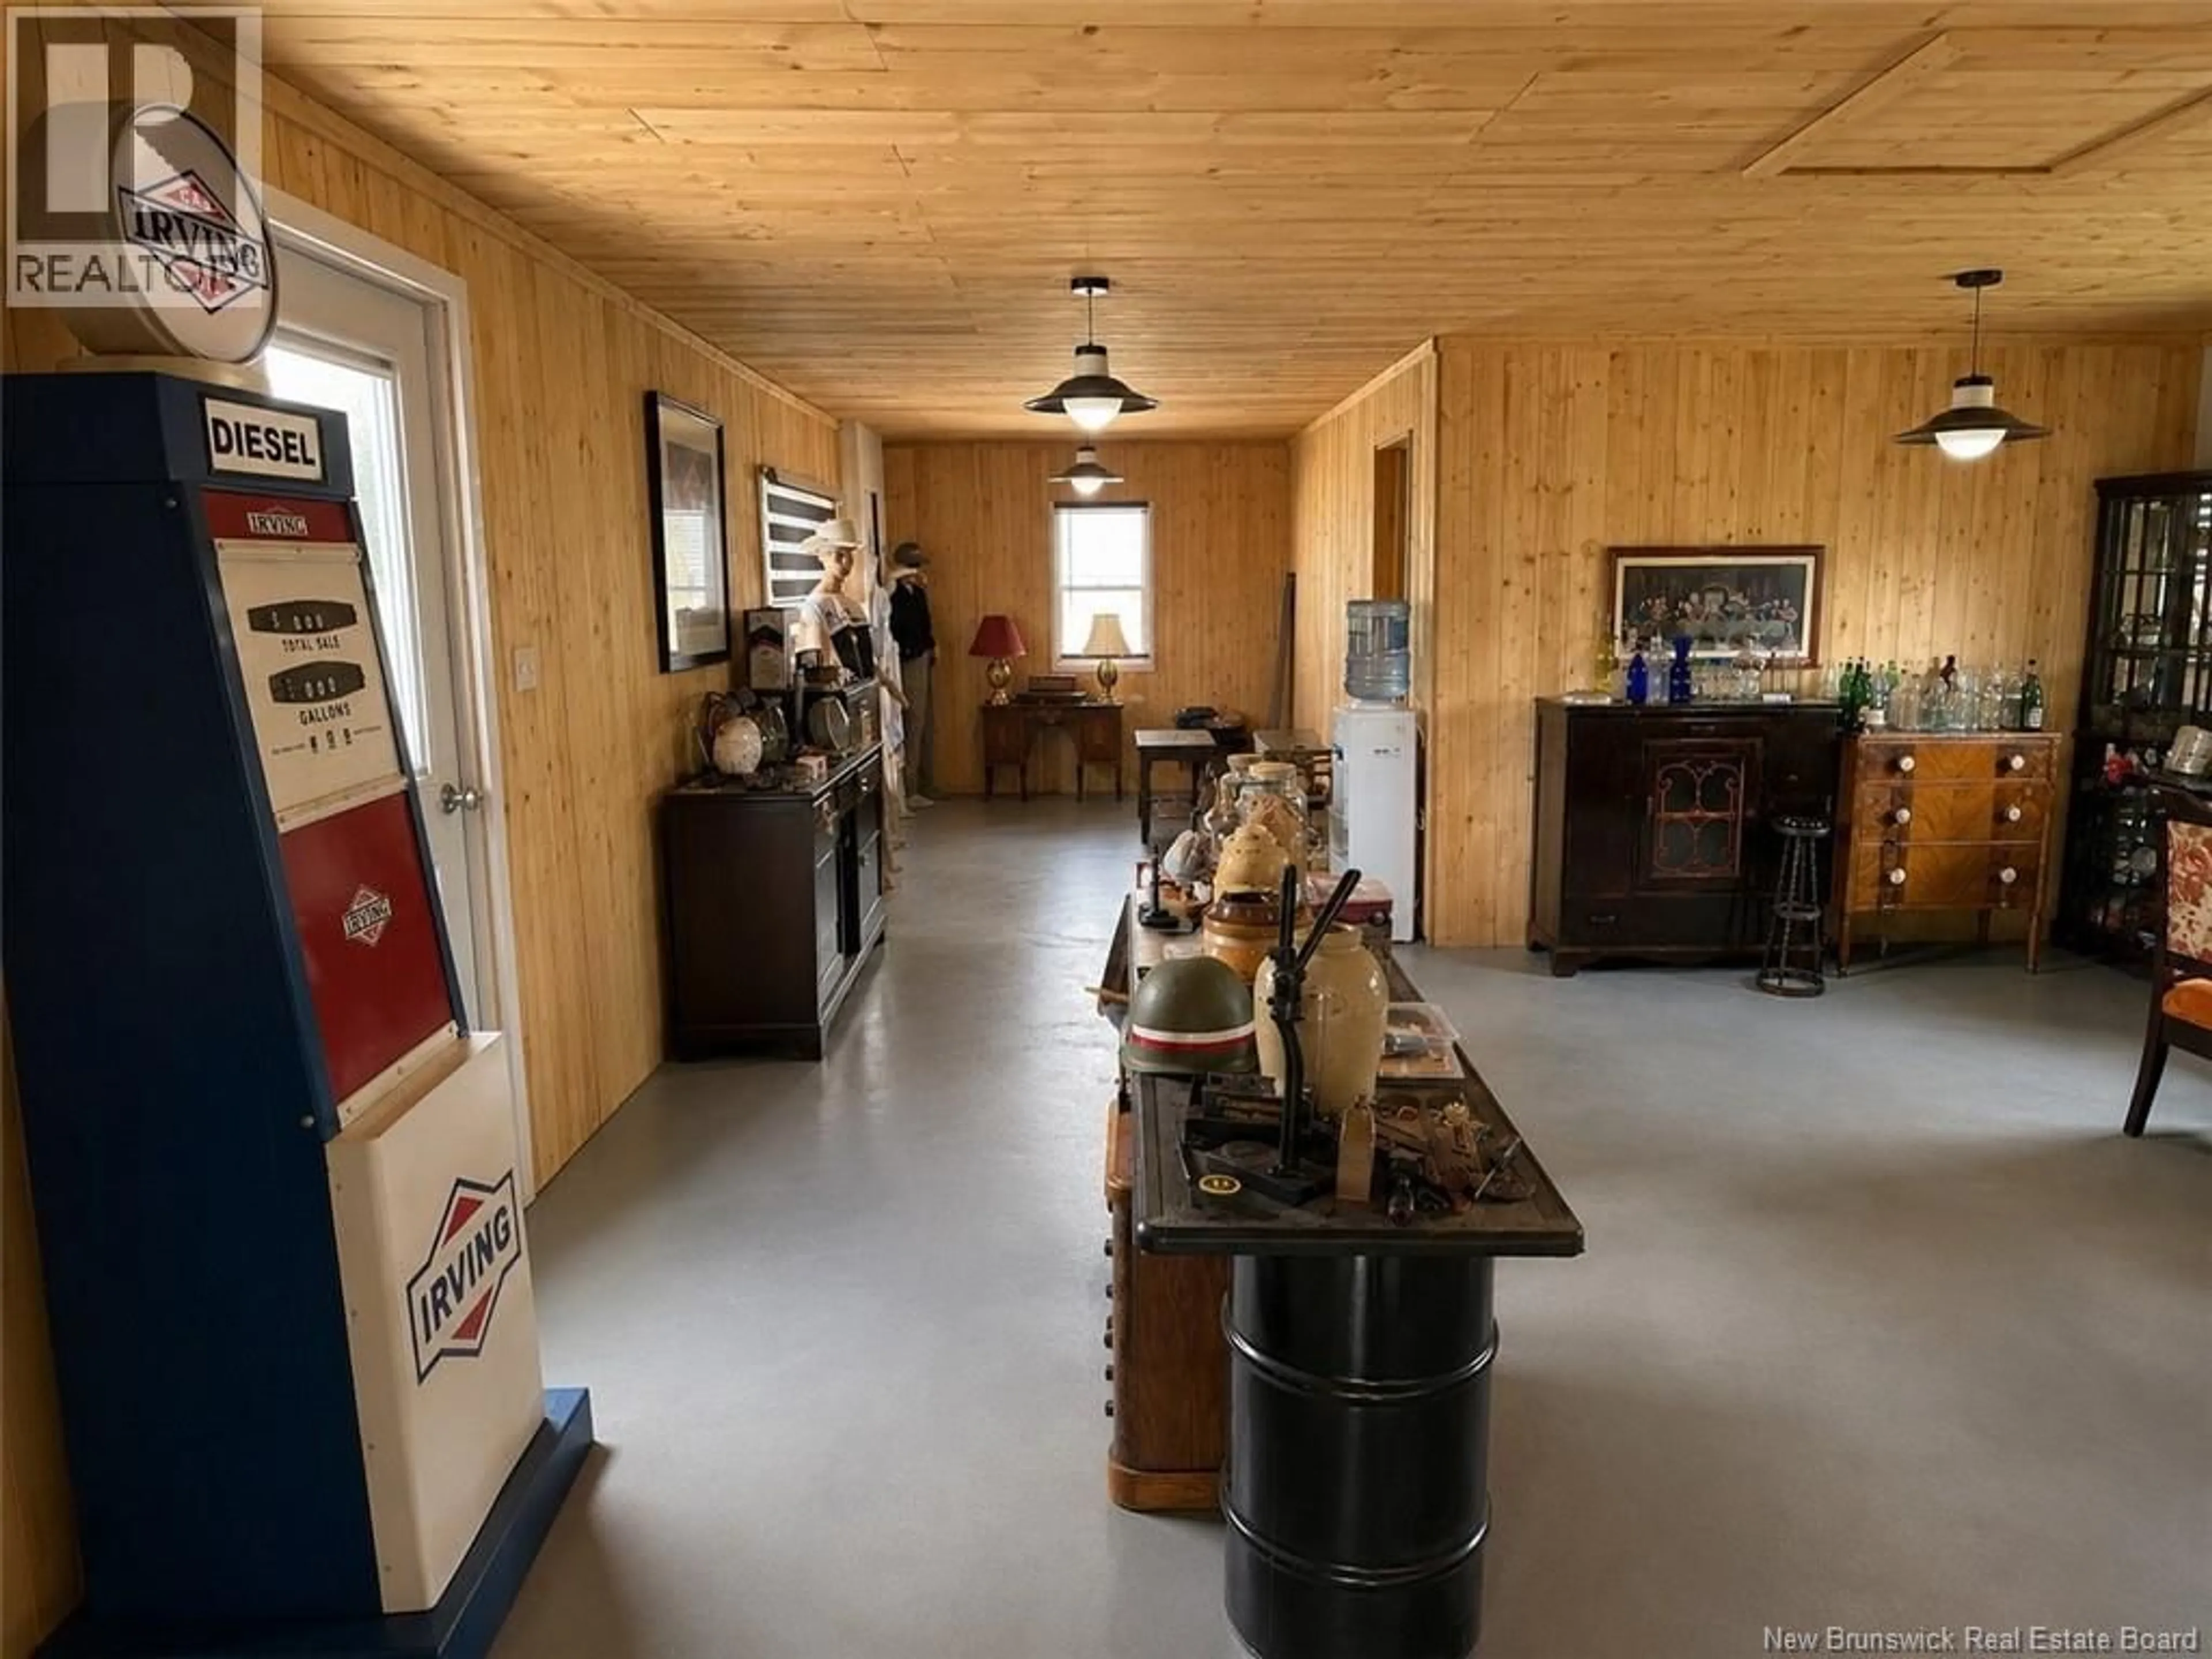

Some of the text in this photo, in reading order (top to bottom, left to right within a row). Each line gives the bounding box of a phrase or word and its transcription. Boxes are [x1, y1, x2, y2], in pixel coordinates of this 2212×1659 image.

[134, 211, 259, 277] IRVING
[211, 416, 316, 467] DIESEL
[251, 513, 306, 536] IRVING
[281, 634, 340, 653] TOTAL SALE
[299, 702, 351, 726] GALLONS
[346, 901, 390, 934] IRVING
[421, 1205, 512, 1345] IRVING
